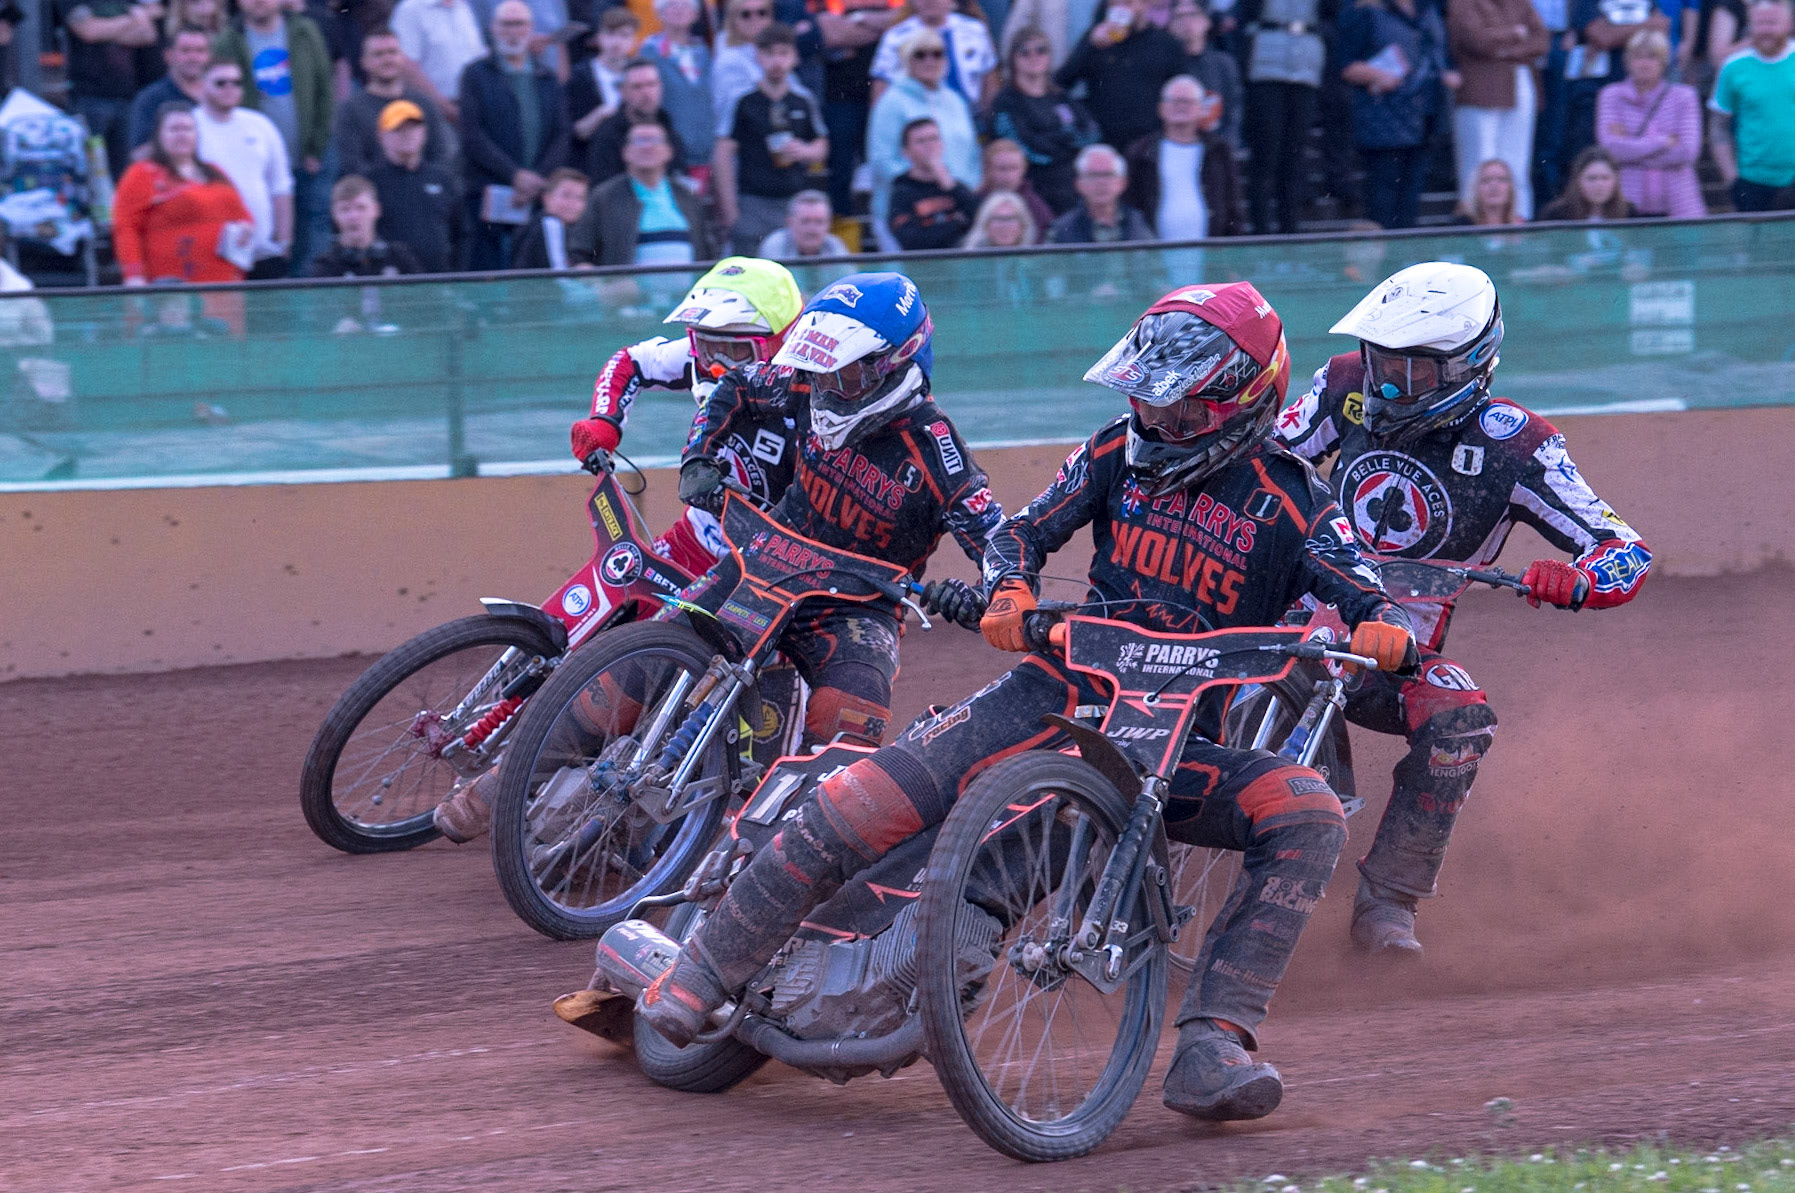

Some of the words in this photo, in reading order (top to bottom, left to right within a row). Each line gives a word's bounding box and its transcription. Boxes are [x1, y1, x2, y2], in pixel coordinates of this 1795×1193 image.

[1488, 411, 1518, 428] ATPI
[728, 435, 744, 454] UE
[757, 434, 781, 457] 5
[938, 435, 963, 474] UNIT
[1463, 448, 1474, 472] 1
[800, 462, 895, 550] WOLVES
[1351, 457, 1391, 482] BELLE
[1396, 460, 1422, 482] VUE
[1421, 483, 1446, 518] ACES
[1151, 491, 1257, 553] PARRYS
[757, 553, 823, 590] INTERNATONAL
[763, 533, 835, 580] PARRYS
[1110, 519, 1246, 616] WOLVES
[1142, 664, 1215, 679] INTERNAONAL
[1145, 643, 1222, 669] PARRYS
[1106, 726, 1171, 740] JWP
[750, 773, 799, 819] 1
